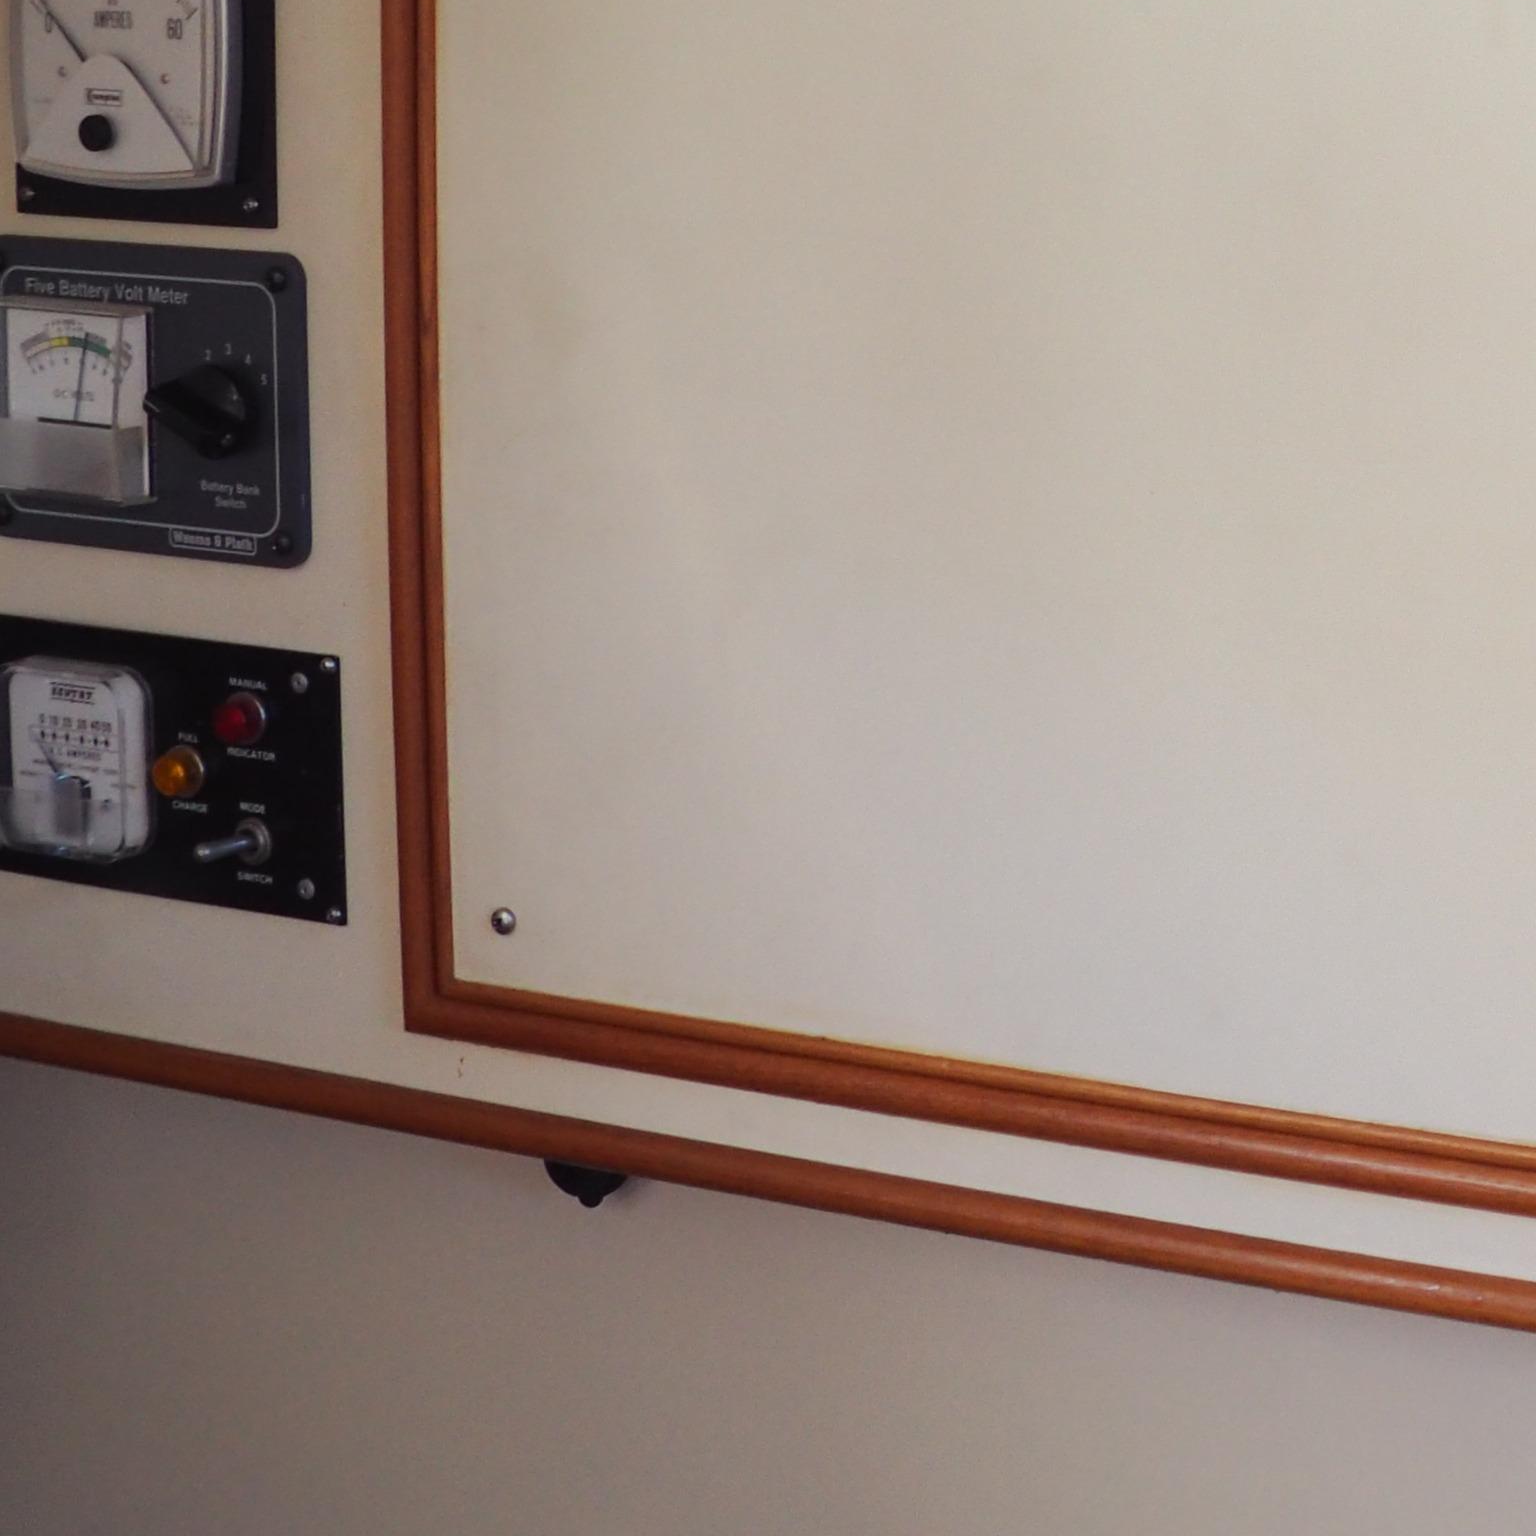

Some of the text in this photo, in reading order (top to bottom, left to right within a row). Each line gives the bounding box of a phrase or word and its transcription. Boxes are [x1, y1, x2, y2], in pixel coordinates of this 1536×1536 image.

[166, 18, 183, 41] 60
[24, 277, 189, 305] Five Battery Volt Meter
[204, 349, 213, 362] 2
[244, 353, 252, 366] 4
[260, 373, 269, 386] 5
[201, 479, 233, 496] Battery
[229, 676, 269, 691] MANUAL
[178, 732, 201, 745] FULL
[227, 748, 276, 763] INDICATOR
[171, 801, 209, 814] CHARGE
[239, 801, 266, 815] MODE
[237, 871, 274, 886] SWITCH
